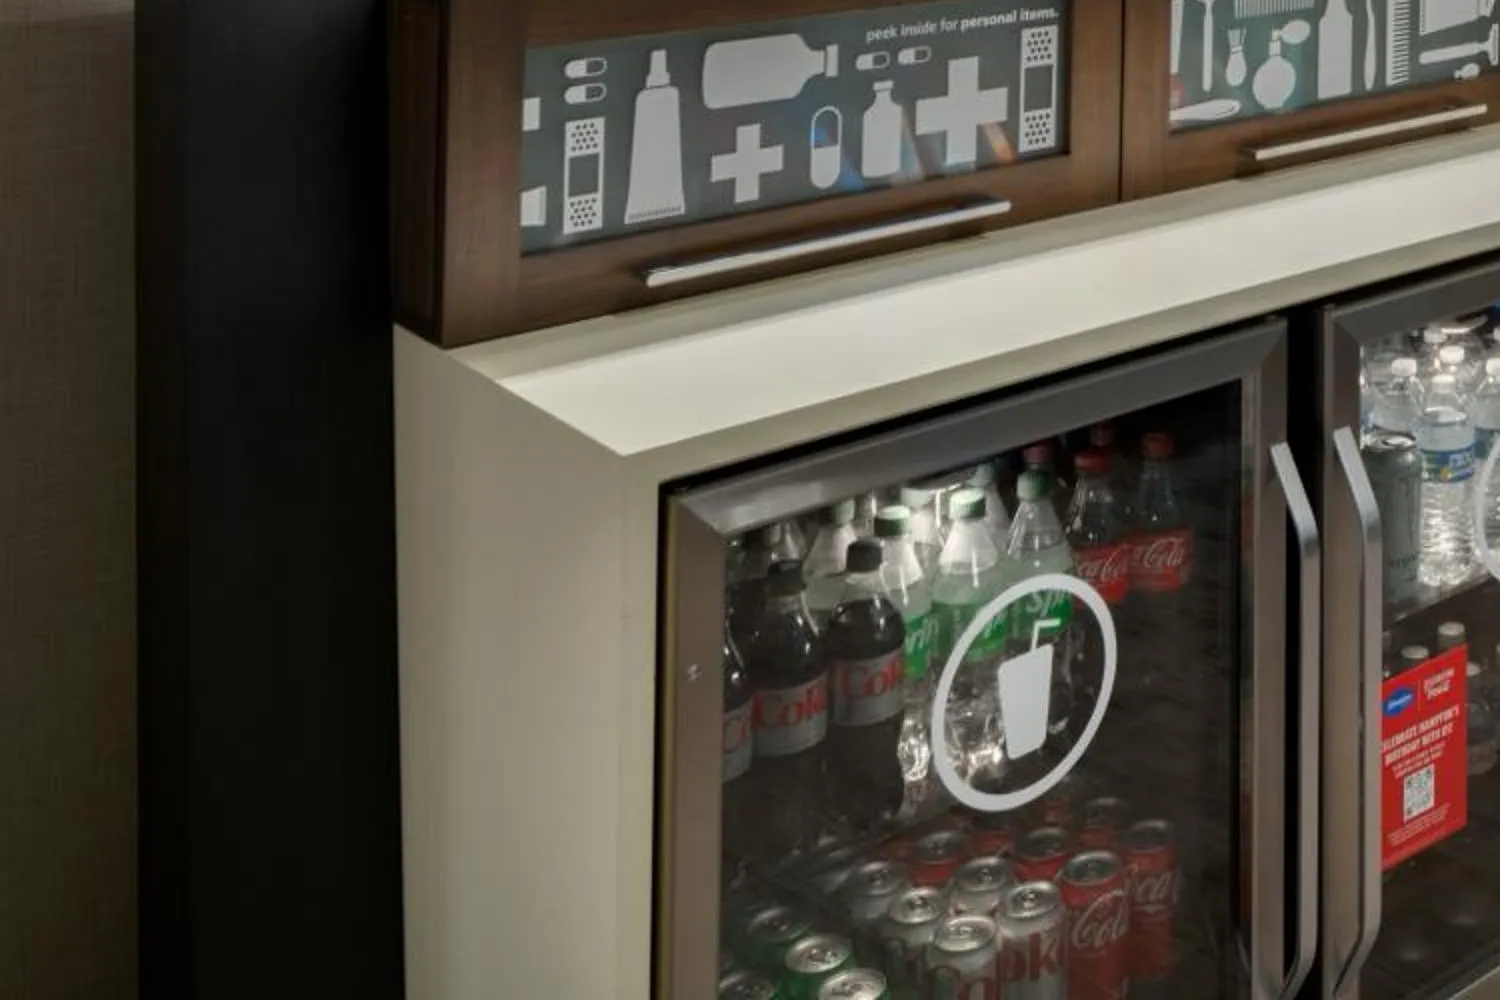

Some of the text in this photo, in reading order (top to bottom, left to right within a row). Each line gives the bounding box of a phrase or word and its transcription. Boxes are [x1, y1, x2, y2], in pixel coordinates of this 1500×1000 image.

[866, 27, 897, 44] peek
[901, 22, 936, 36] inside
[940, 16, 957, 31] for
[960, 9, 1017, 33] personal
